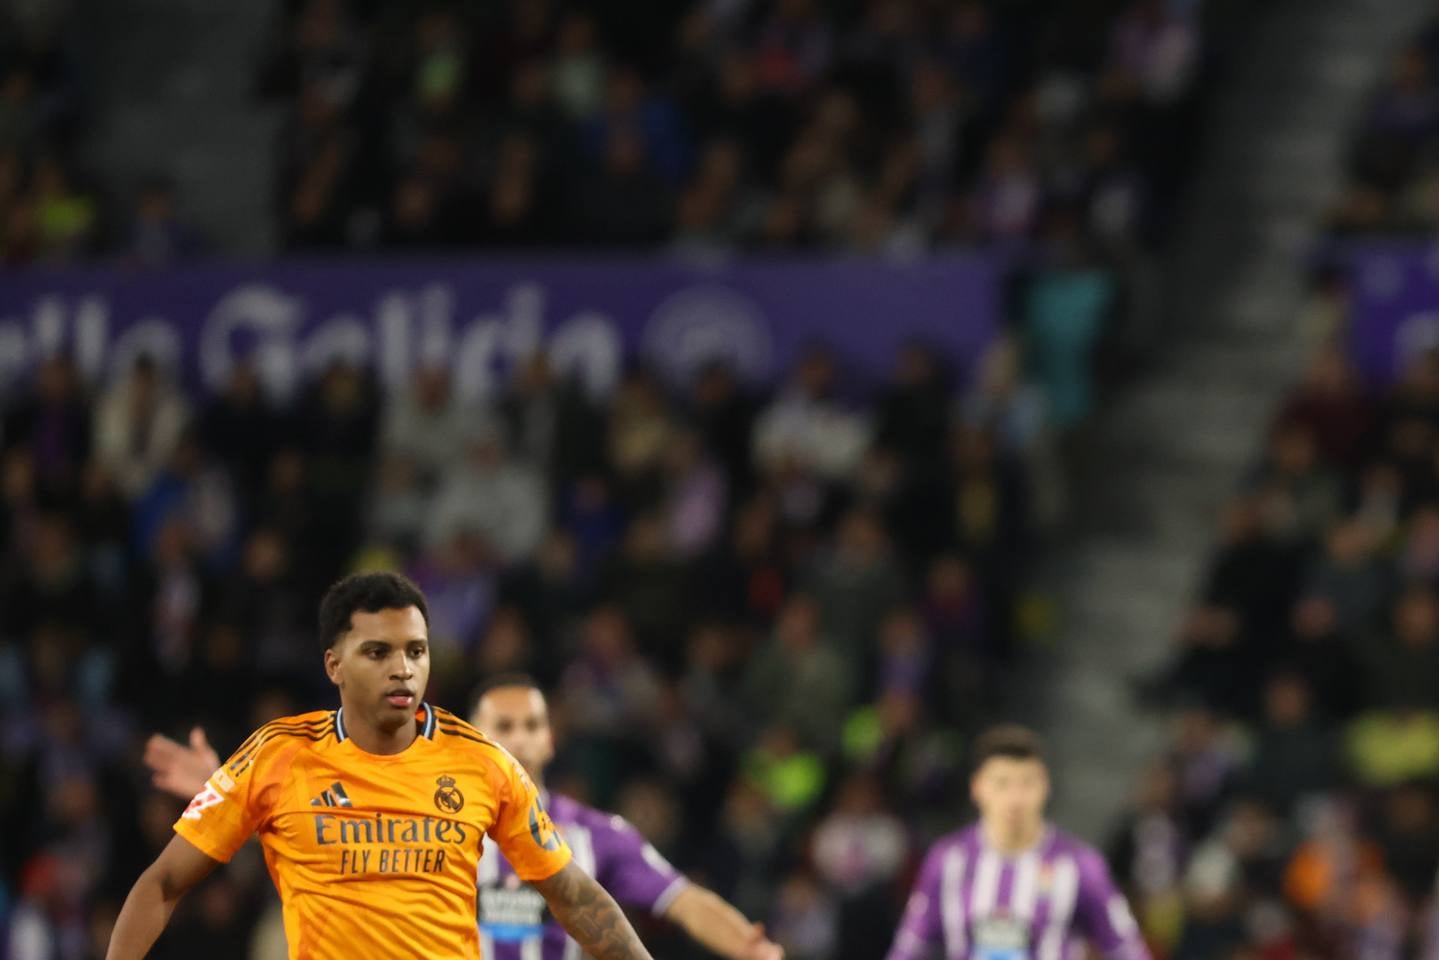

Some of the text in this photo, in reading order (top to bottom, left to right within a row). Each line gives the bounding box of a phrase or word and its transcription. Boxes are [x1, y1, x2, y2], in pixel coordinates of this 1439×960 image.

[315, 812, 466, 845] Emirates
[340, 848, 446, 874] FLY BETTER
